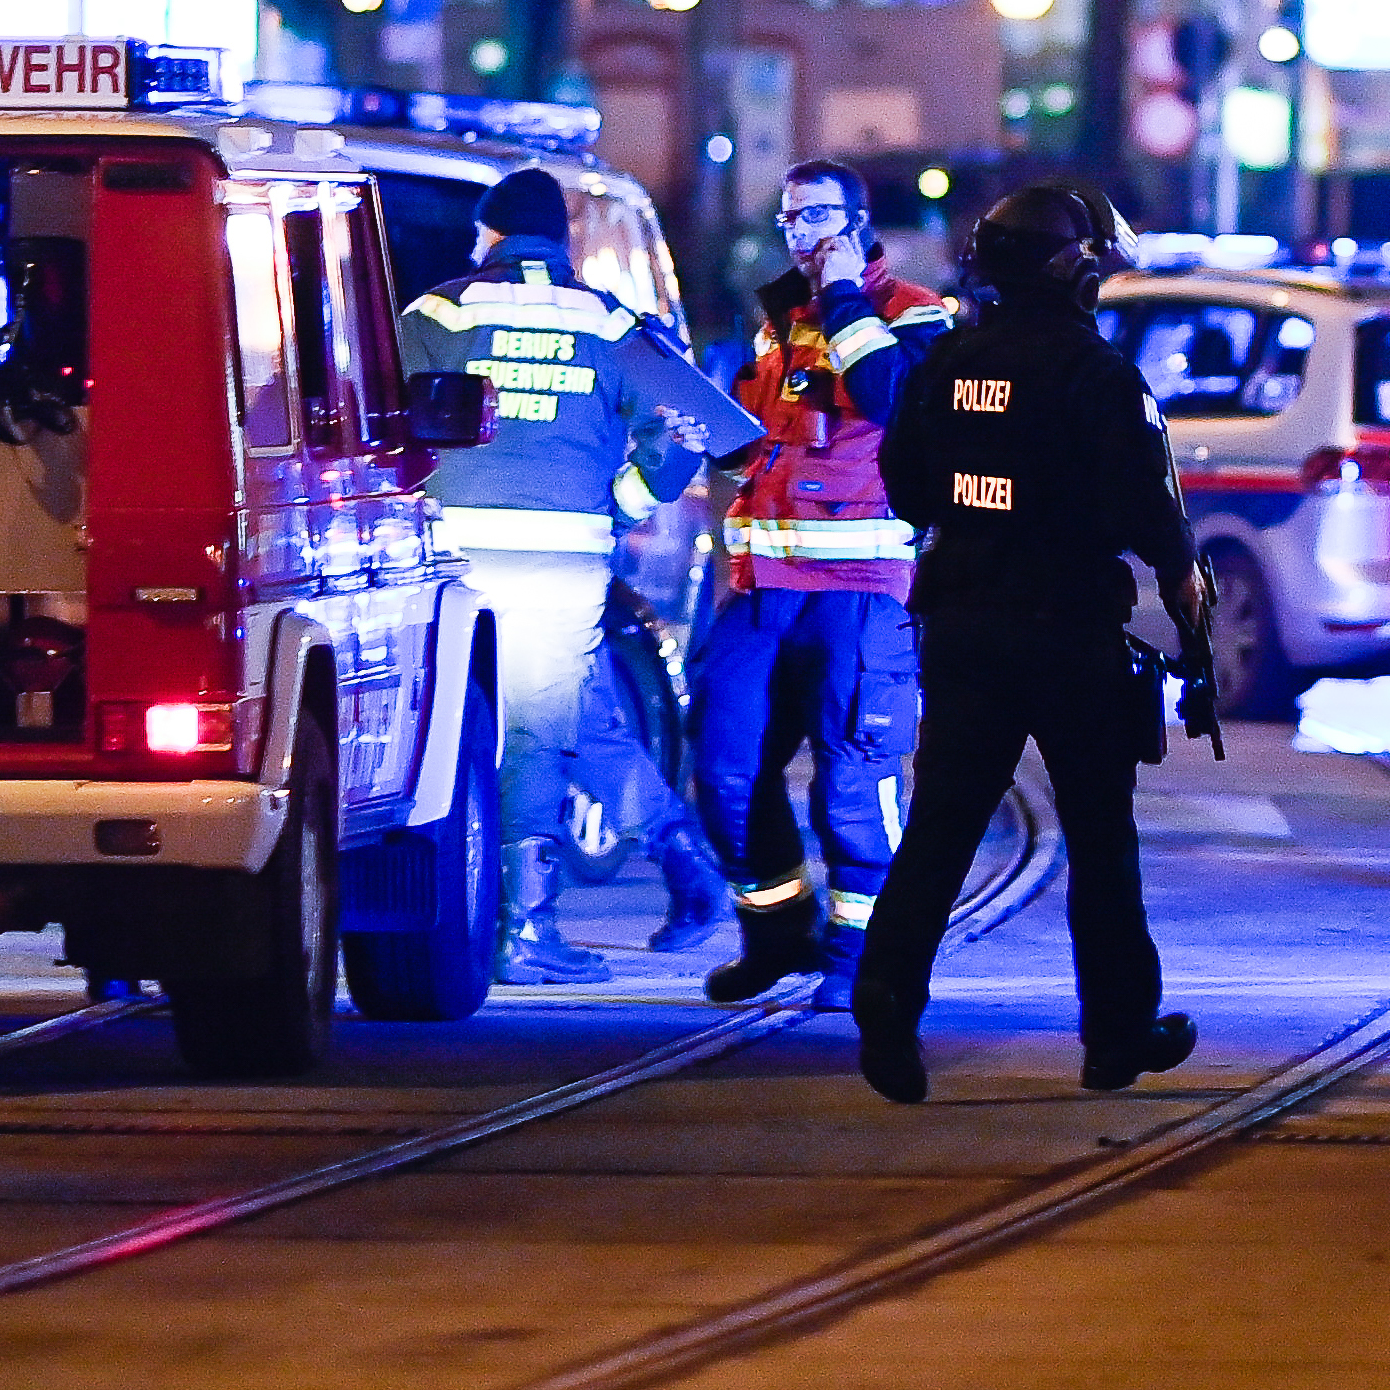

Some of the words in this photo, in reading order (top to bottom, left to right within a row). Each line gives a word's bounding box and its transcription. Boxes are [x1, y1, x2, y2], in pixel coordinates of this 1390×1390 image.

[491, 329, 576, 362] BERUFS
[497, 391, 559, 422] WIEN
[953, 378, 1011, 413] POLIZEI
[953, 472, 1012, 511] POLIZEI
